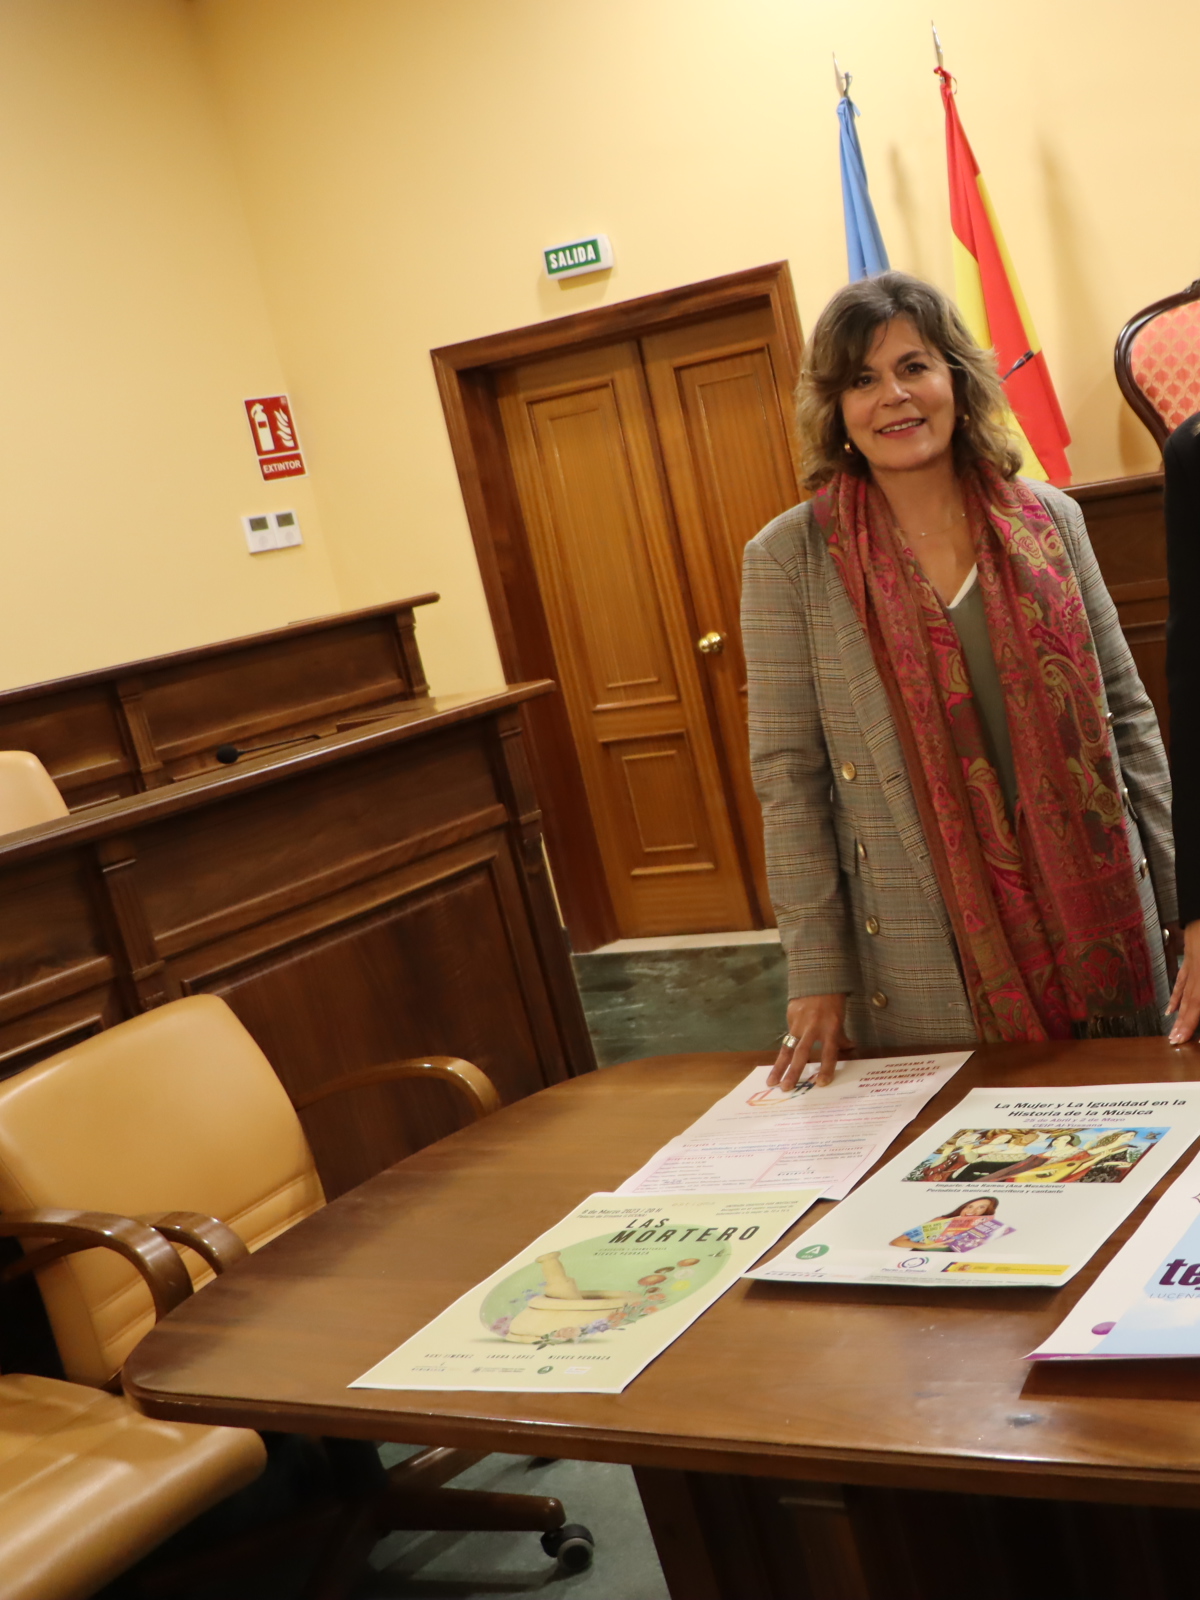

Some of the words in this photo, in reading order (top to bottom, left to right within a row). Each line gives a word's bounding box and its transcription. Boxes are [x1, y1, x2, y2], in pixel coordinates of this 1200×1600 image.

[549, 244, 597, 269] SALIDA
[263, 460, 302, 474] EXTINTOR
[1013, 1101, 1053, 1111] Mujer
[1055, 1102, 1065, 1110] y
[1087, 1099, 1149, 1108] Igualdad
[1173, 1098, 1187, 1106] la
[1085, 1108, 1098, 1116] la
[1102, 1107, 1154, 1116] Música
[626, 1218, 670, 1229] LAS
[608, 1225, 761, 1244] MORTERO
